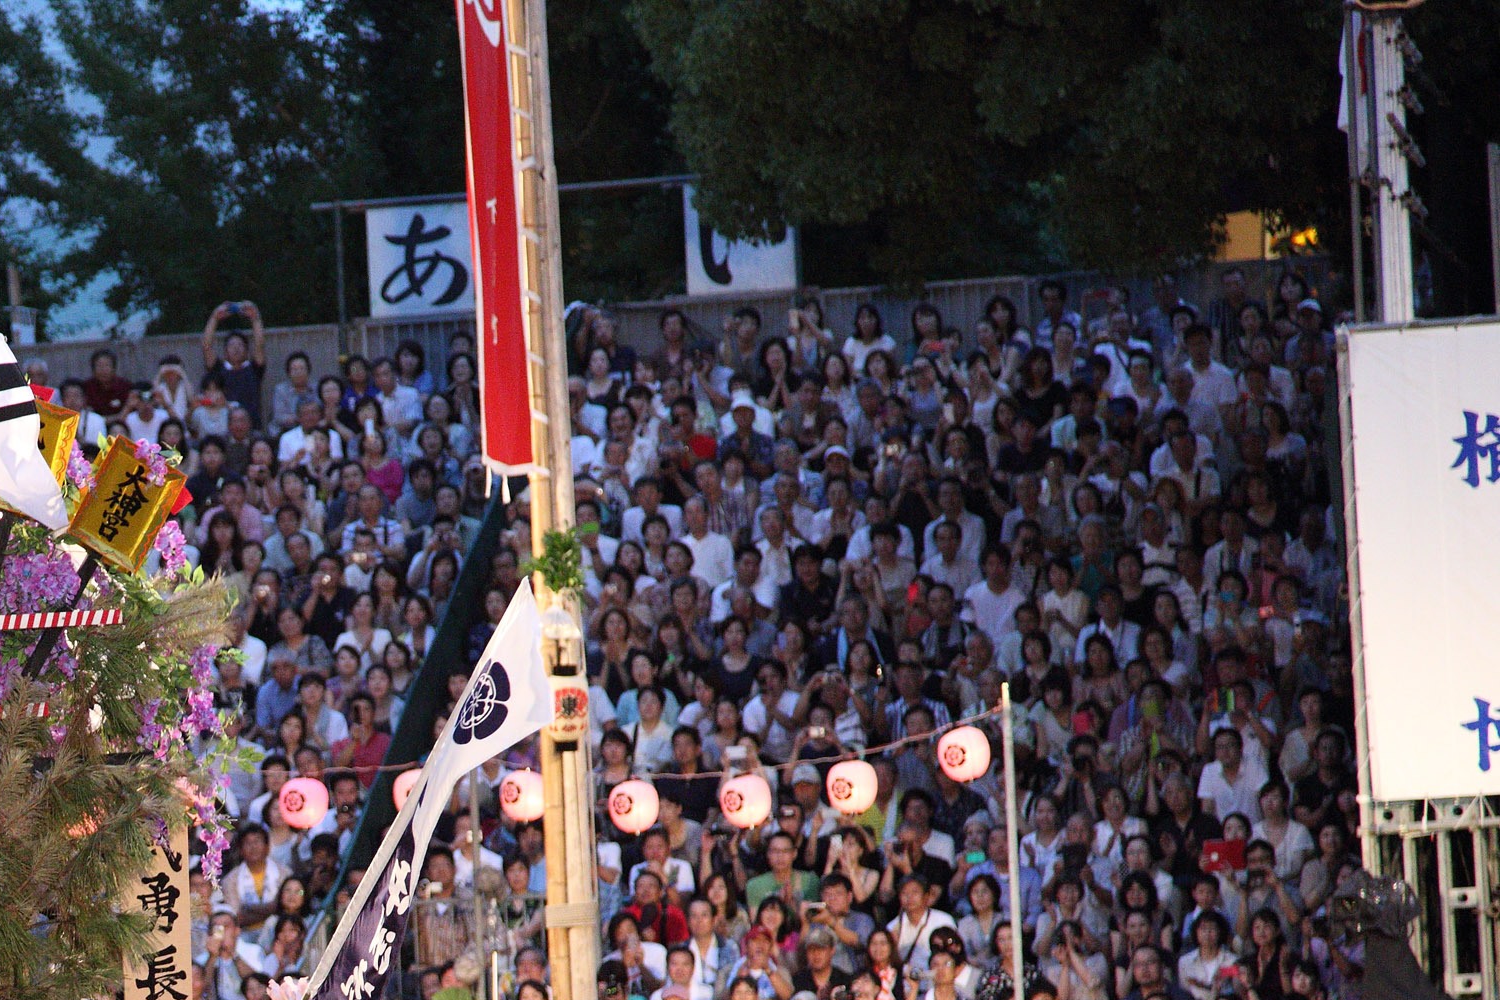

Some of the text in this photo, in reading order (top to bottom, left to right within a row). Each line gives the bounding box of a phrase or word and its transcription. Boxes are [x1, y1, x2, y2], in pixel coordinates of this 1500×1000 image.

[381, 212, 469, 306] あ
[98, 465, 150, 542] 大神宮
